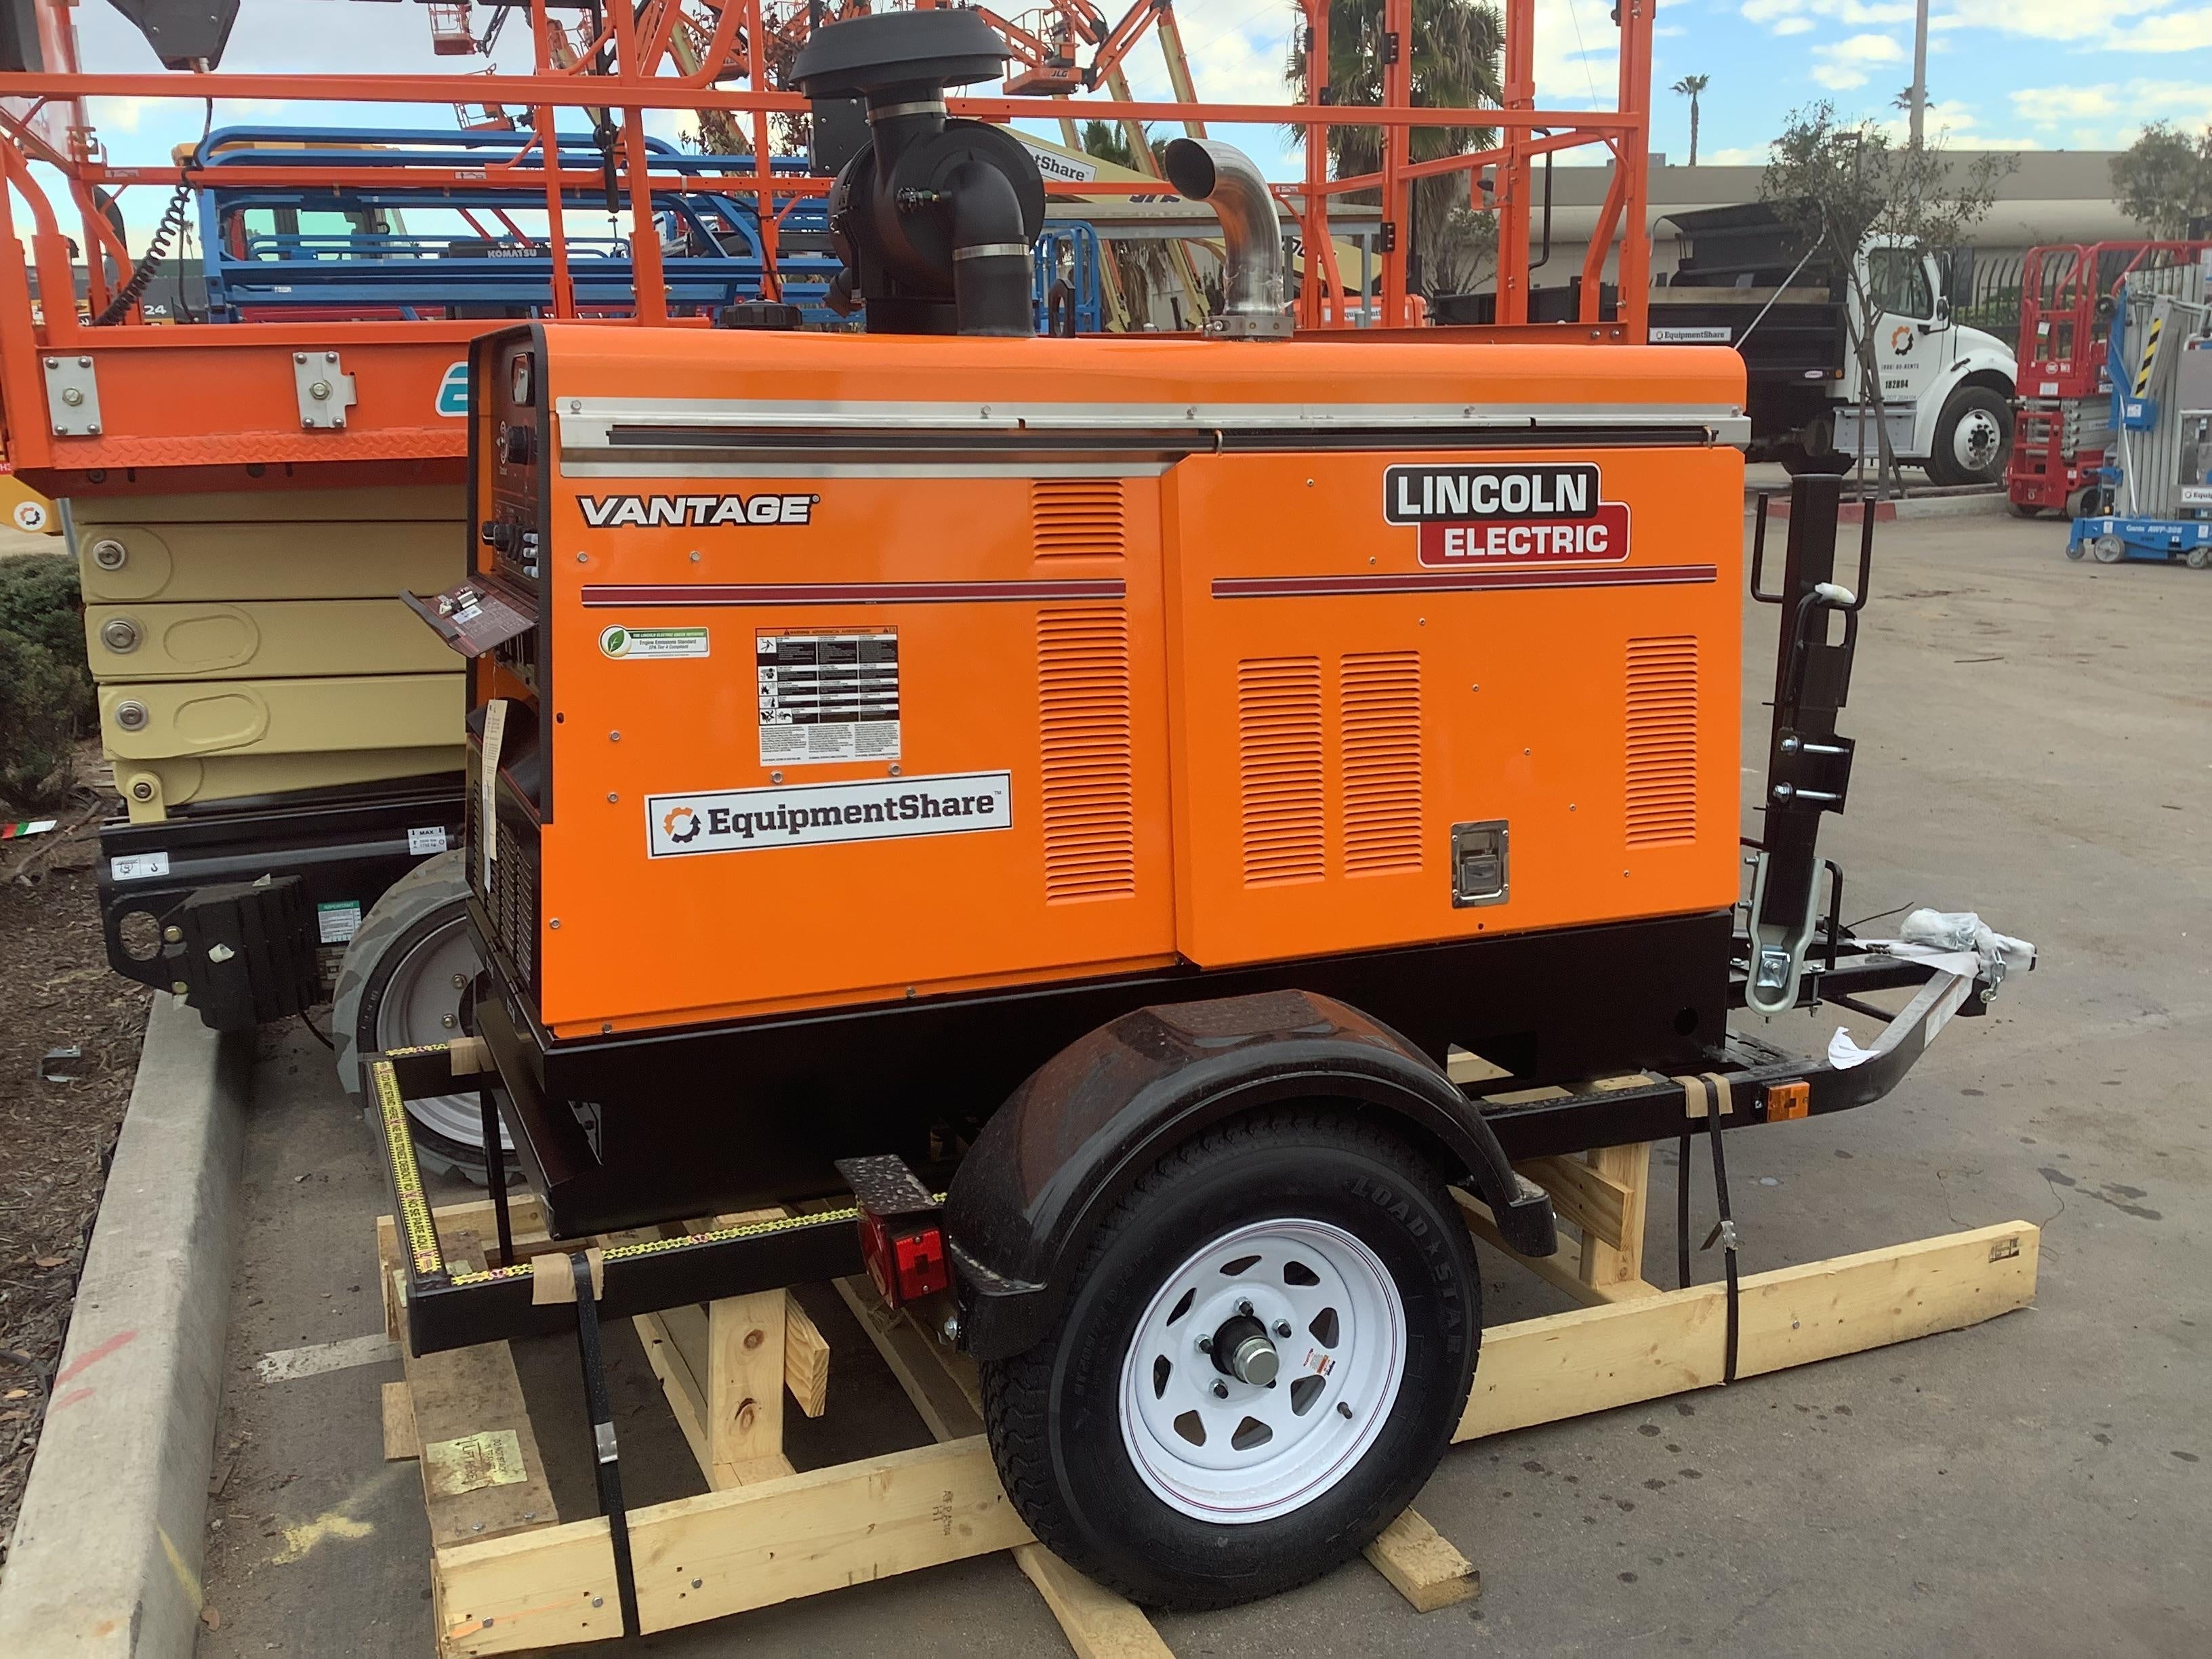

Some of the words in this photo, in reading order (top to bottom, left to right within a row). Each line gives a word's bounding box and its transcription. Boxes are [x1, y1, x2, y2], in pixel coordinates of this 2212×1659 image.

[1052, 70, 1068, 78] JLG
[487, 249, 537, 258] KOMATSU
[1664, 331, 1725, 340] EquipmentShare
[1398, 474, 1586, 515] LINCOLN
[579, 496, 811, 525] VANTAGE
[1444, 525, 1608, 557] ELECTRIC
[708, 793, 995, 839] EquipmentShare
[384, 1090, 396, 1107] STAND
[398, 1160, 413, 1185] DEBOUT
[407, 1198, 418, 1208] NO
[409, 1208, 421, 1218] SE
[411, 1217, 426, 1235] PARE
[1351, 1174, 1429, 1237] LOAD
[1433, 1261, 1464, 1353] STAR
